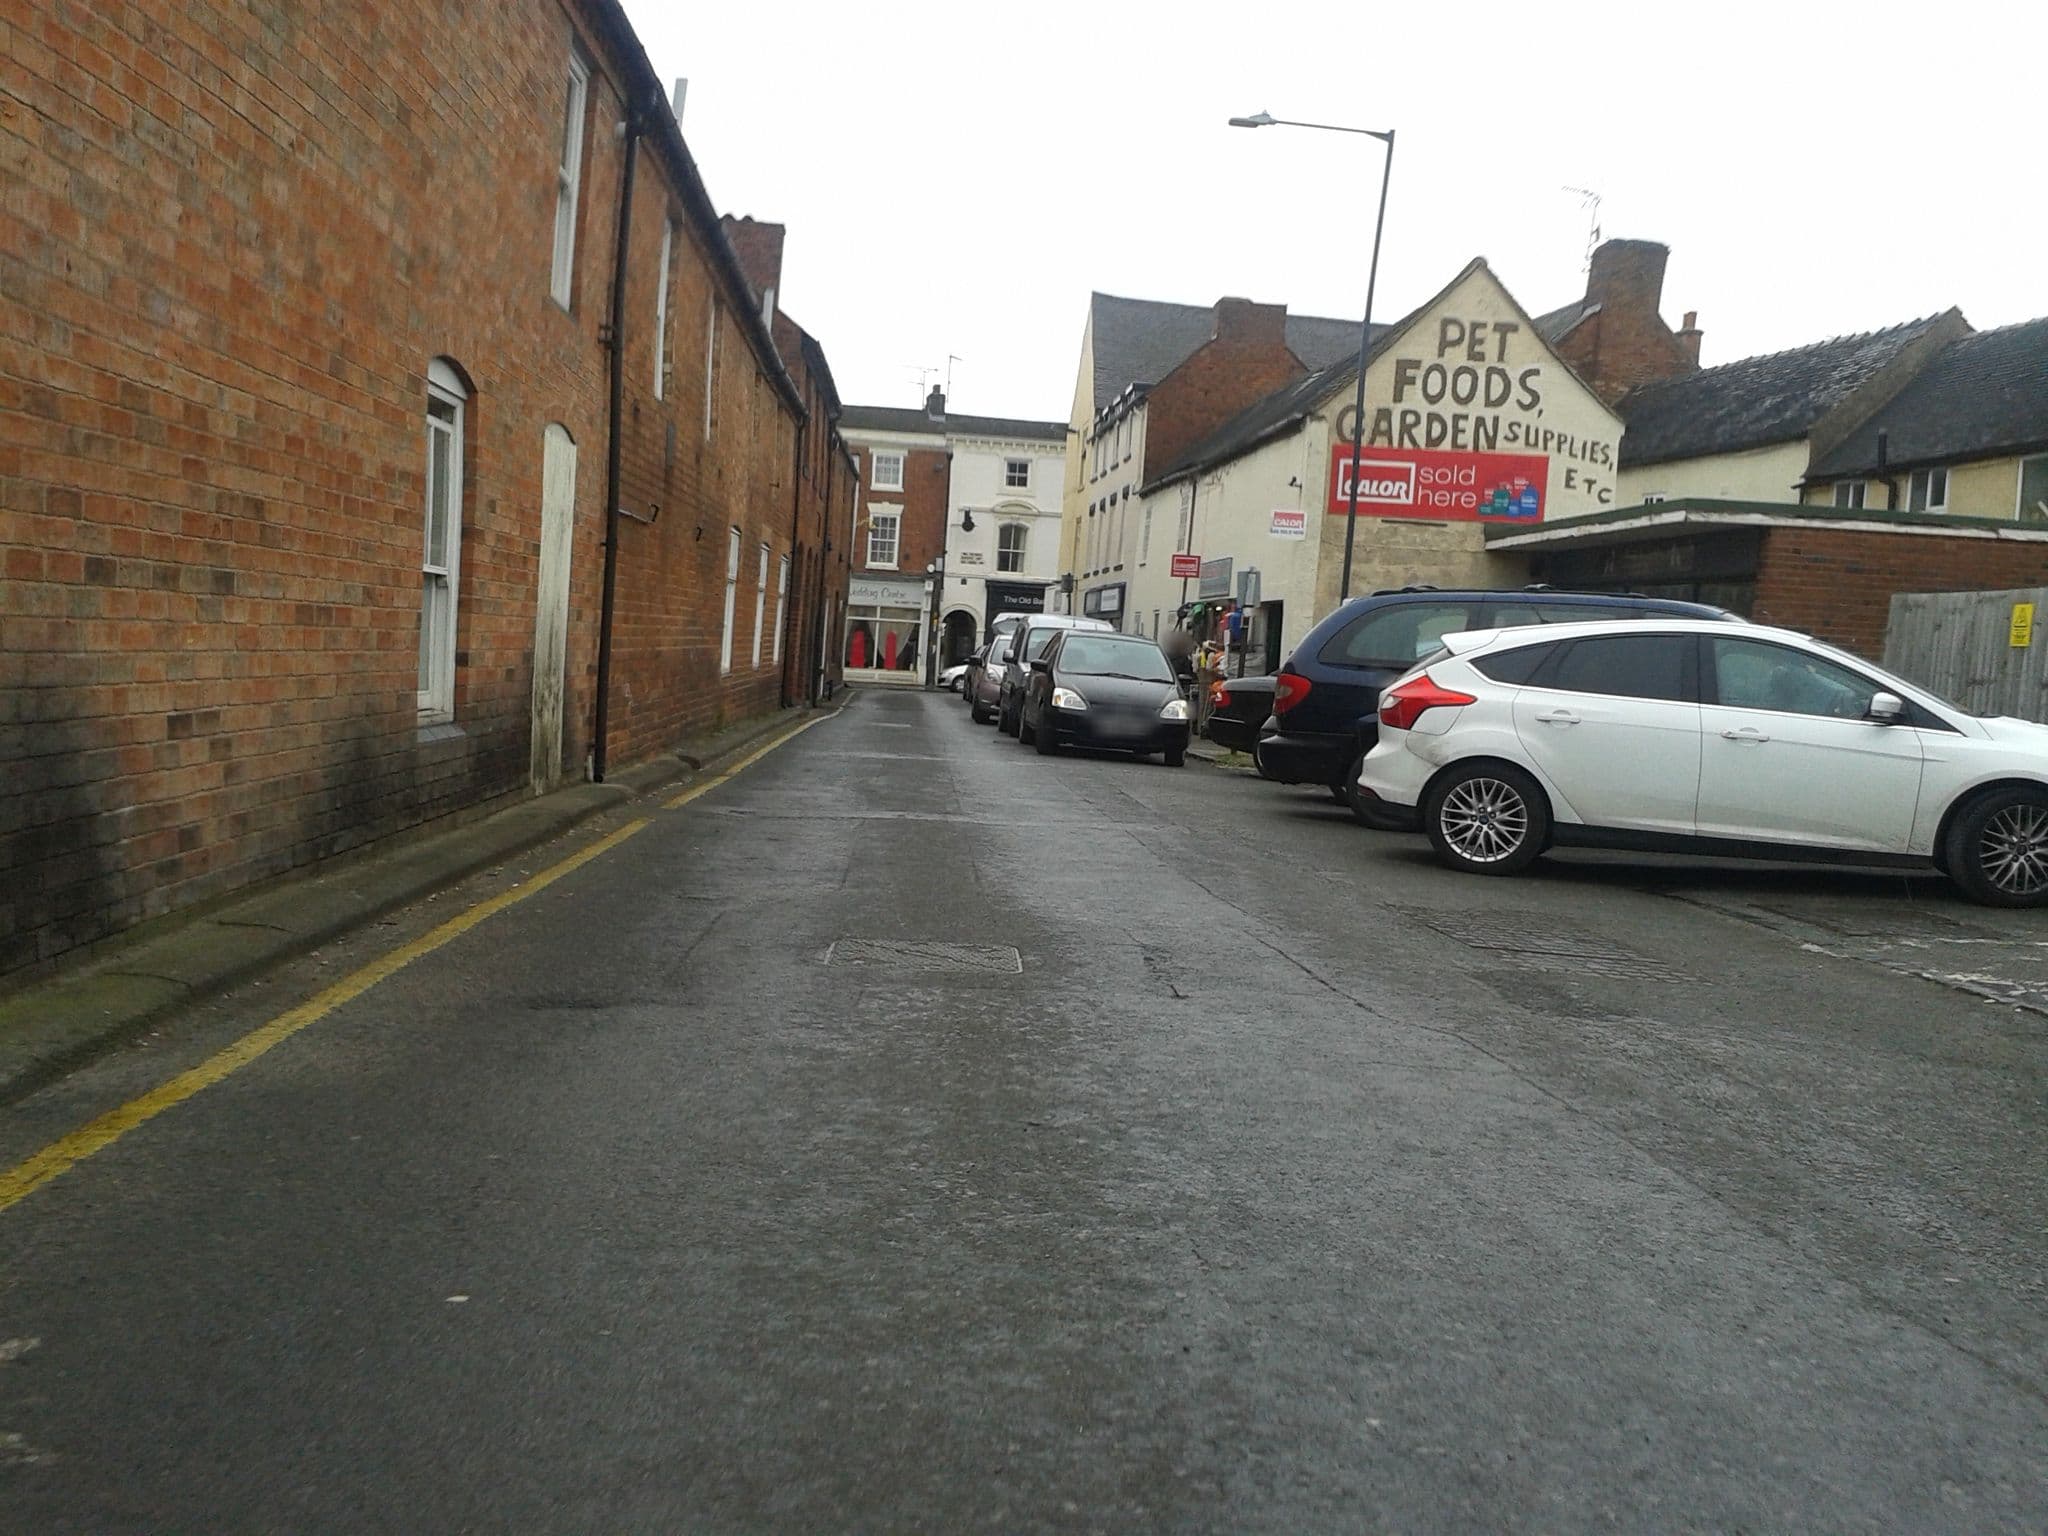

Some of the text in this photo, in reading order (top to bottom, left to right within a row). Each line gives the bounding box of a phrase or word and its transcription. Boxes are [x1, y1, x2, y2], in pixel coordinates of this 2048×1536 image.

[1437, 317, 1520, 362] PET
[1392, 358, 1542, 418] FOODS,
[1335, 404, 1614, 472] GARDEN SUPPLIES,
[1418, 464, 1477, 486] sold
[1344, 479, 1408, 502] CALOR
[1417, 486, 1477, 508] here
[1004, 595, 1018, 603] The
[1019, 596, 1032, 605] Old
